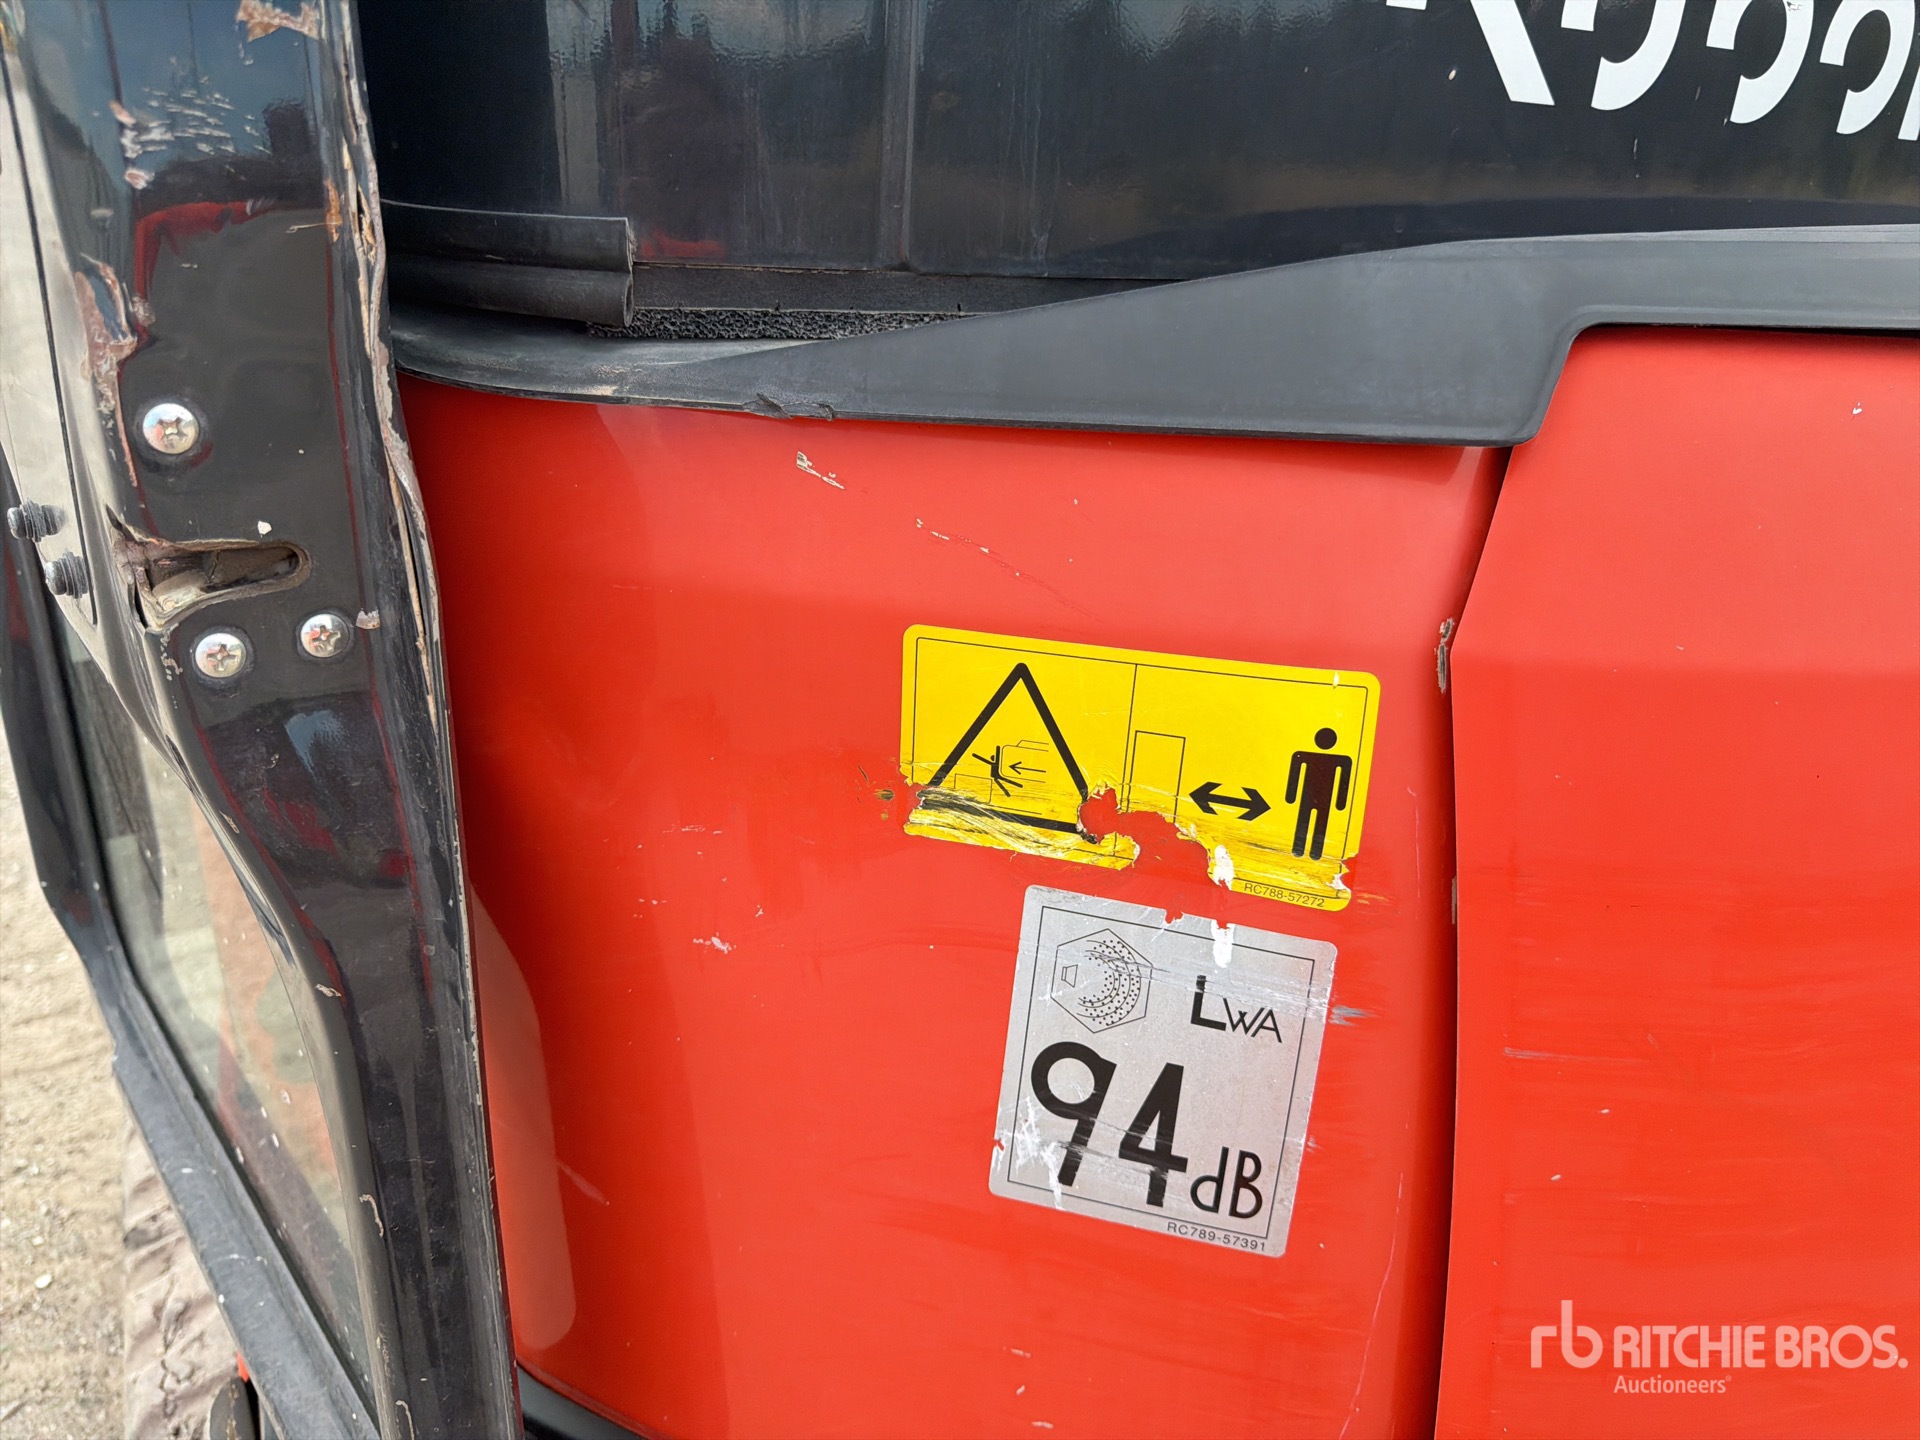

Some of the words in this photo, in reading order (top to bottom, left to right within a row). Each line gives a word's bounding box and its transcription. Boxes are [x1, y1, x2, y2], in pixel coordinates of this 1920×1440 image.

[1243, 882, 1326, 908] RC788-57272
[1031, 1041, 1188, 1208] 94
[1190, 1146, 1264, 1219] dB
[1166, 1221, 1267, 1252] RC789-57391
